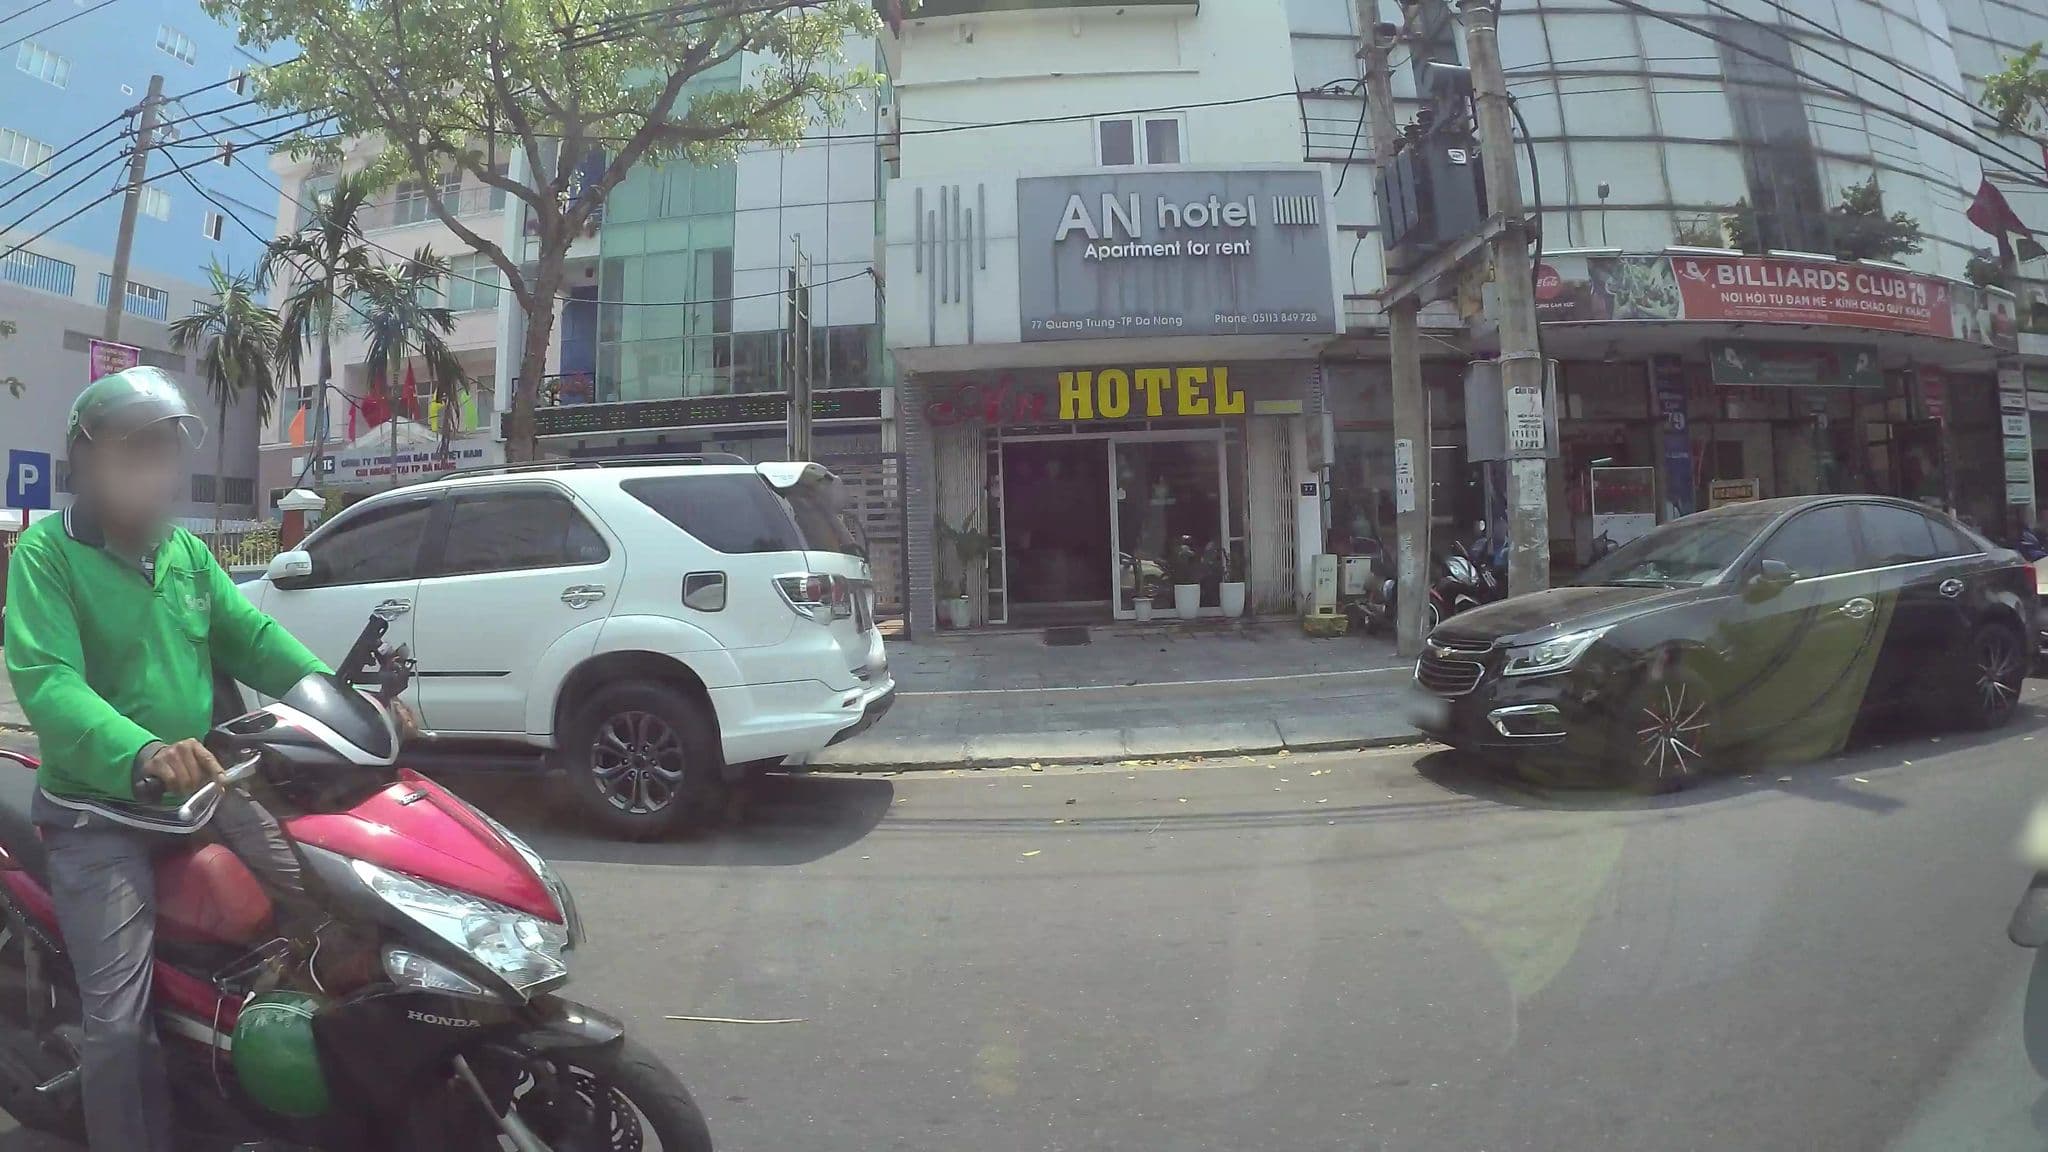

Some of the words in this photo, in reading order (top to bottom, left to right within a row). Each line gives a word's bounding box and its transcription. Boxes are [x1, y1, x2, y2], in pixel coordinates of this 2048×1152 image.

[1055, 192, 1142, 241] AN
[1157, 194, 1257, 229] hotel
[1084, 240, 1181, 261] Apartment
[1187, 239, 1210, 255] for
[1216, 239, 1250, 255] rent
[1716, 263, 1850, 292] BILLIARDS
[1856, 273, 1907, 299] CLUB
[1909, 281, 1927, 306] 79
[1031, 320, 1042, 329] 77
[1045, 319, 1083, 330] Quang
[1153, 315, 1183, 327] Nang
[1057, 366, 1246, 420] HOTEL
[19, 464, 38, 495] P
[407, 1009, 481, 1028] HONDA
